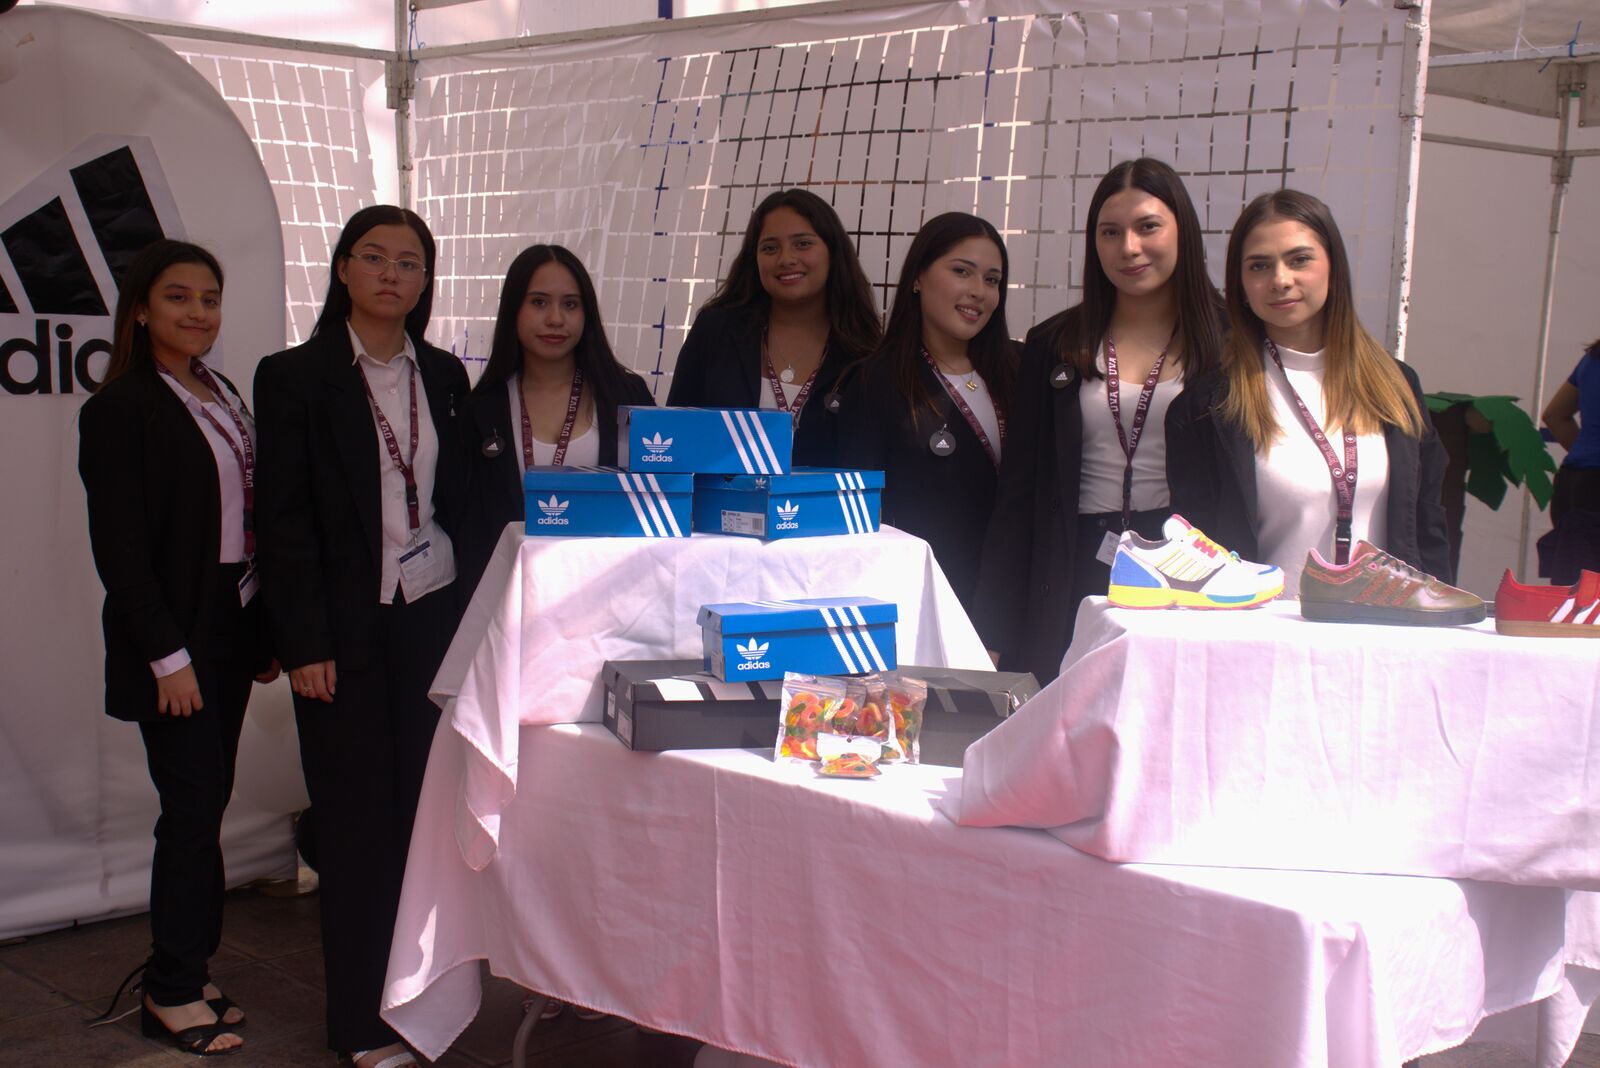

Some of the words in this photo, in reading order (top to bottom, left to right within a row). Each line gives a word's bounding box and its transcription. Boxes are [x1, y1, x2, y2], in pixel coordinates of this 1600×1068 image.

[1108, 357, 1117, 375] UVA
[770, 378, 782, 394] UVA
[800, 380, 814, 395] UVA
[1109, 391, 1119, 412] UVA
[1131, 427, 1141, 448] UVA
[1138, 389, 1152, 410] UVA
[1150, 355, 1164, 375] UVA
[380, 419, 392, 439] UVA
[553, 448, 565, 466] UVA
[561, 421, 573, 437] UVA
[569, 395, 579, 412] UVA
[242, 434, 252, 453] UVA
[641, 454, 673, 463] adidas
[245, 468, 254, 488] UVA
[537, 516, 569, 525] adidas
[776, 521, 799, 530] adidas
[737, 660, 771, 671] adidas
